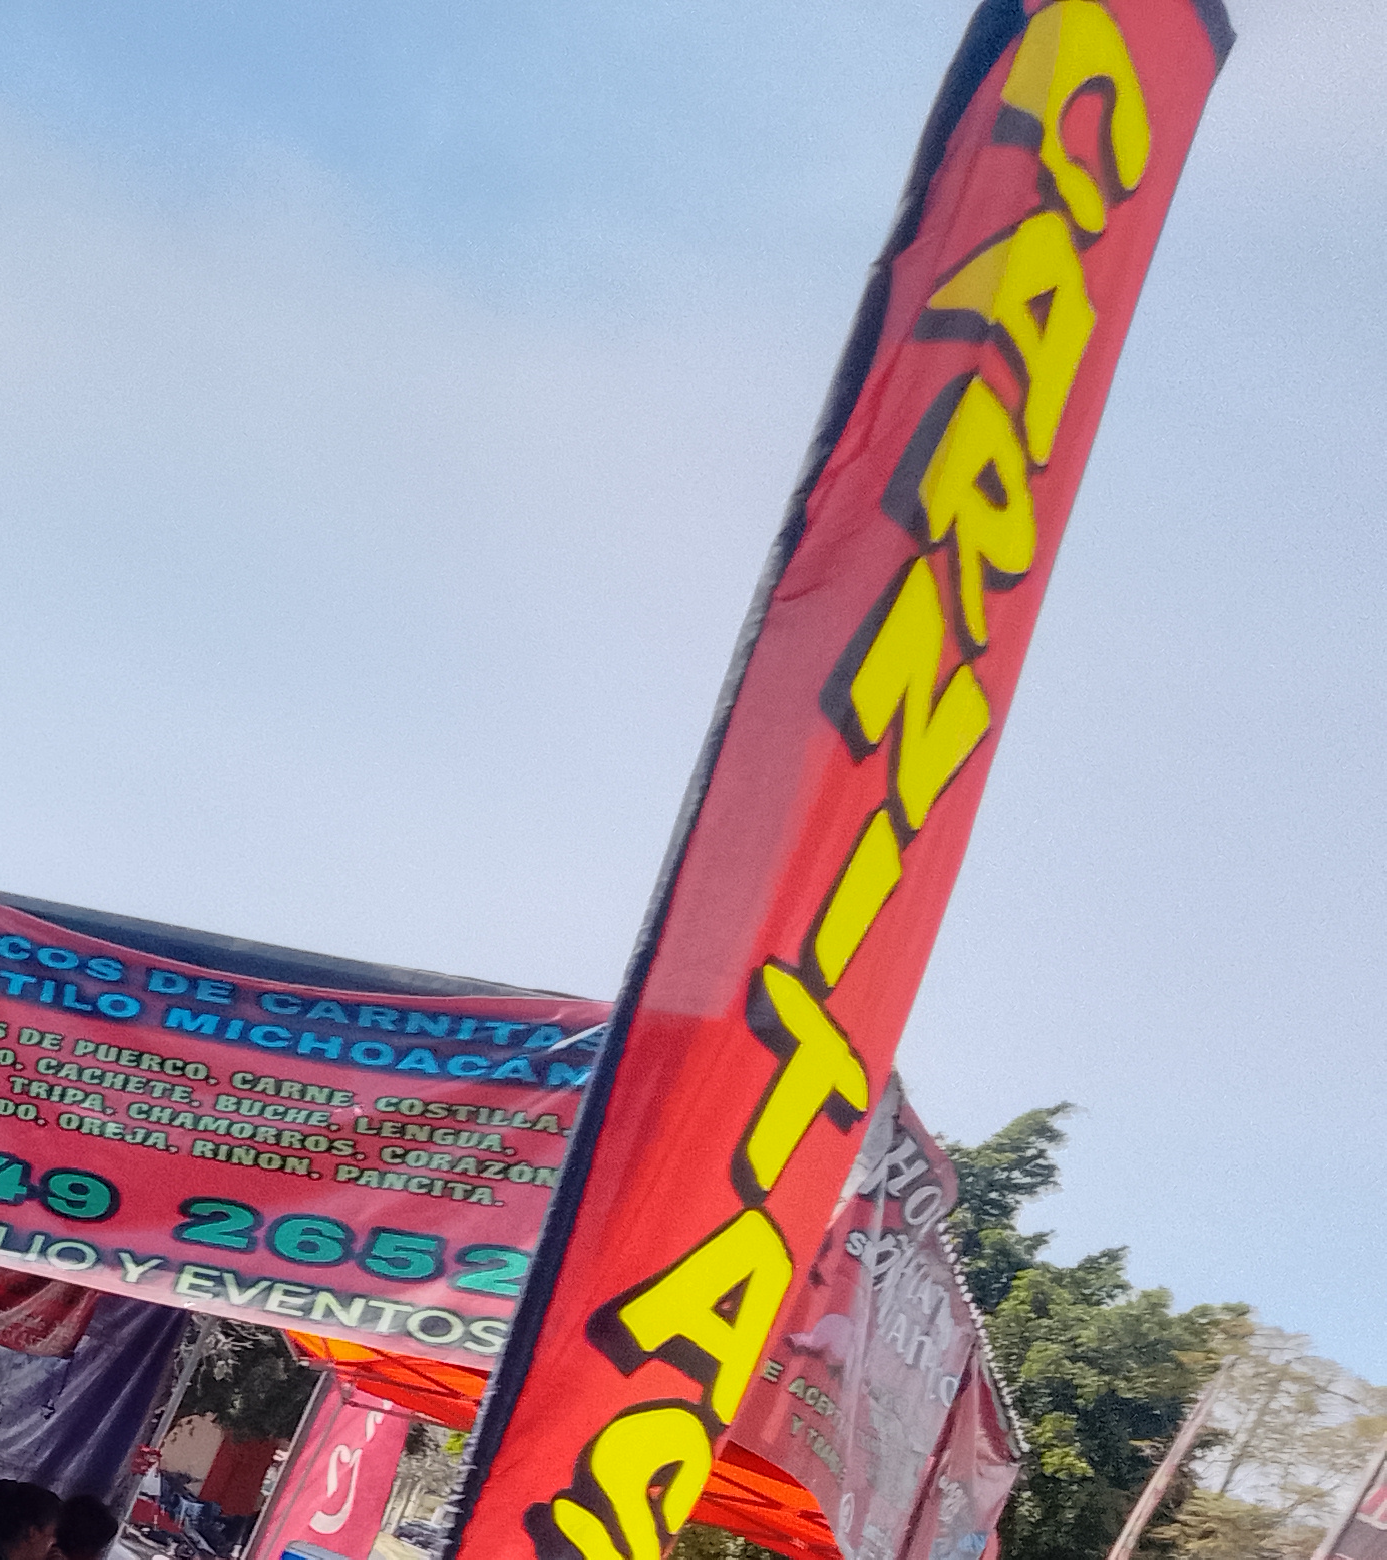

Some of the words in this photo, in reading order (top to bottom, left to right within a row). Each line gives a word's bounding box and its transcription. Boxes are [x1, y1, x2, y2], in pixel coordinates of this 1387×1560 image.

[18, 1027, 65, 1051] DE
[147, 969, 236, 1005] DE
[261, 992, 606, 1051] CARNITAS
[163, 1006, 592, 1087] MICHOACÁN
[175, 1197, 531, 1297] 2652
[118, 1250, 165, 1284] Y
[173, 1263, 511, 1356] EVENTOS
